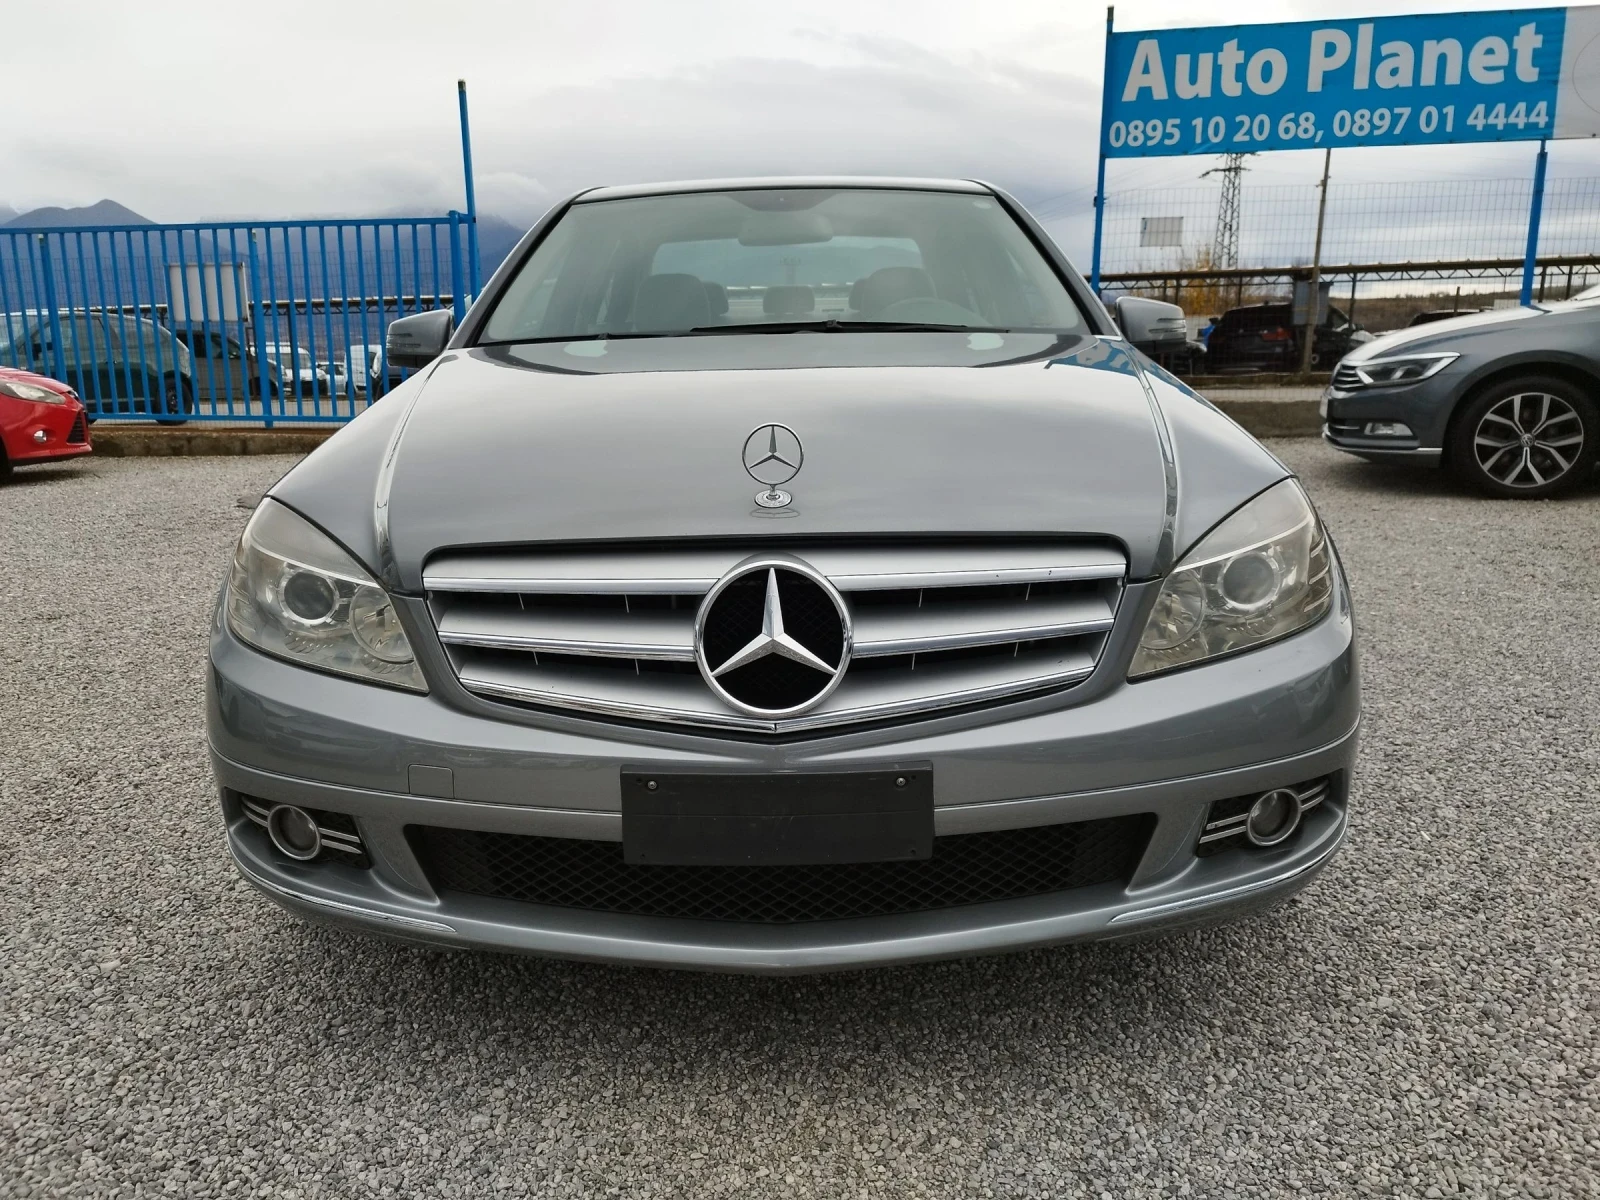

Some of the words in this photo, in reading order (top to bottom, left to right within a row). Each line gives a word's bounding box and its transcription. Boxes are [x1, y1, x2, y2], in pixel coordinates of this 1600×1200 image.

[1121, 38, 1288, 102] Auto
[1307, 22, 1543, 92] Planet
[1109, 117, 1181, 147] 0895
[1192, 116, 1226, 143] 10
[1233, 114, 1270, 142] 20
[1278, 112, 1324, 142] 68,
[1333, 107, 1412, 137] 0897
[1419, 105, 1454, 133] 01
[1467, 101, 1549, 130] 4444
